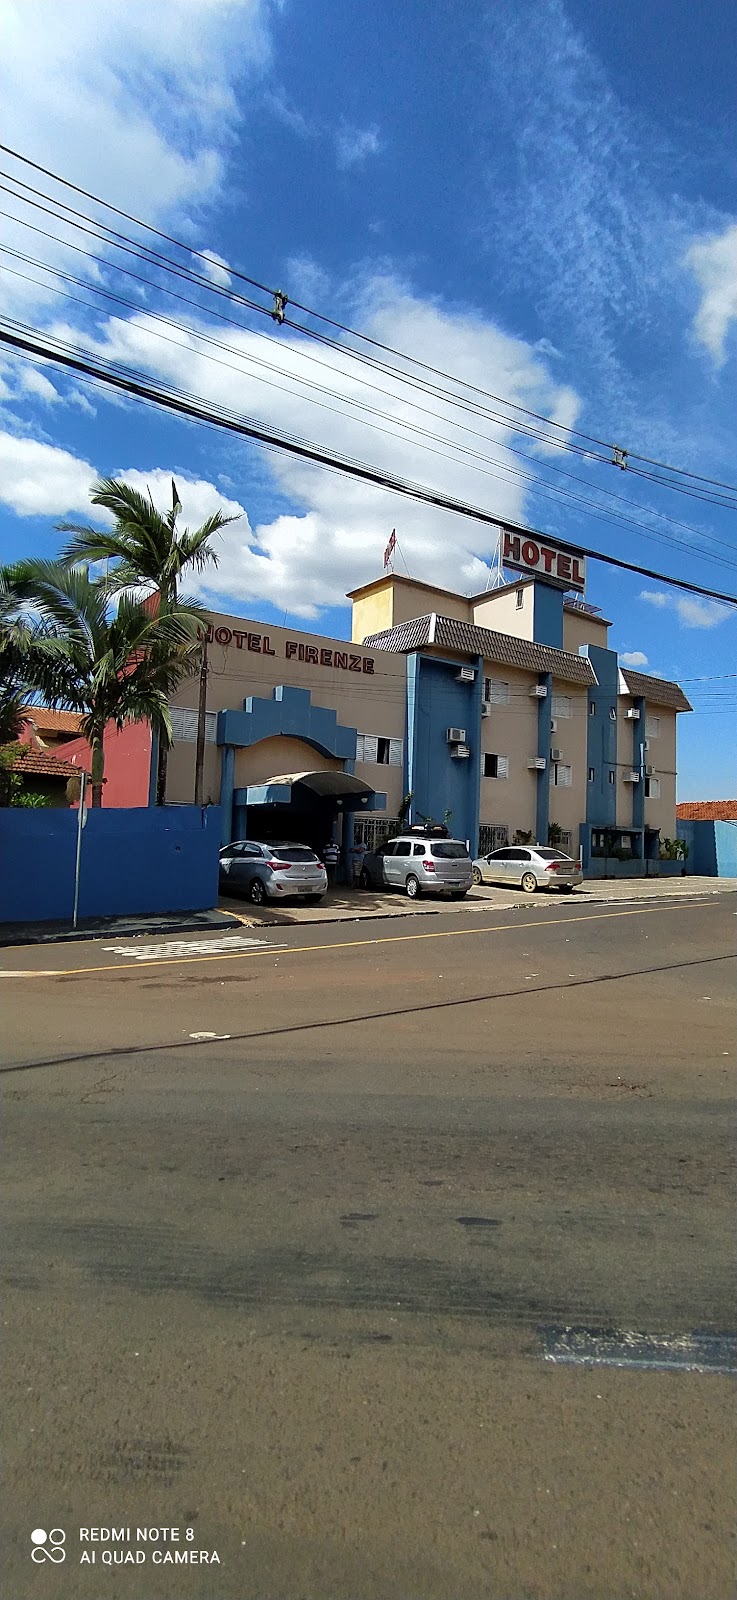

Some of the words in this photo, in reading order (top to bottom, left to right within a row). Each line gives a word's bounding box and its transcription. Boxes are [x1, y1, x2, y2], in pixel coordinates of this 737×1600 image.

[503, 533, 585, 584] HOTEL
[196, 624, 276, 656] HOTEL
[285, 640, 375, 675] FIRENZE
